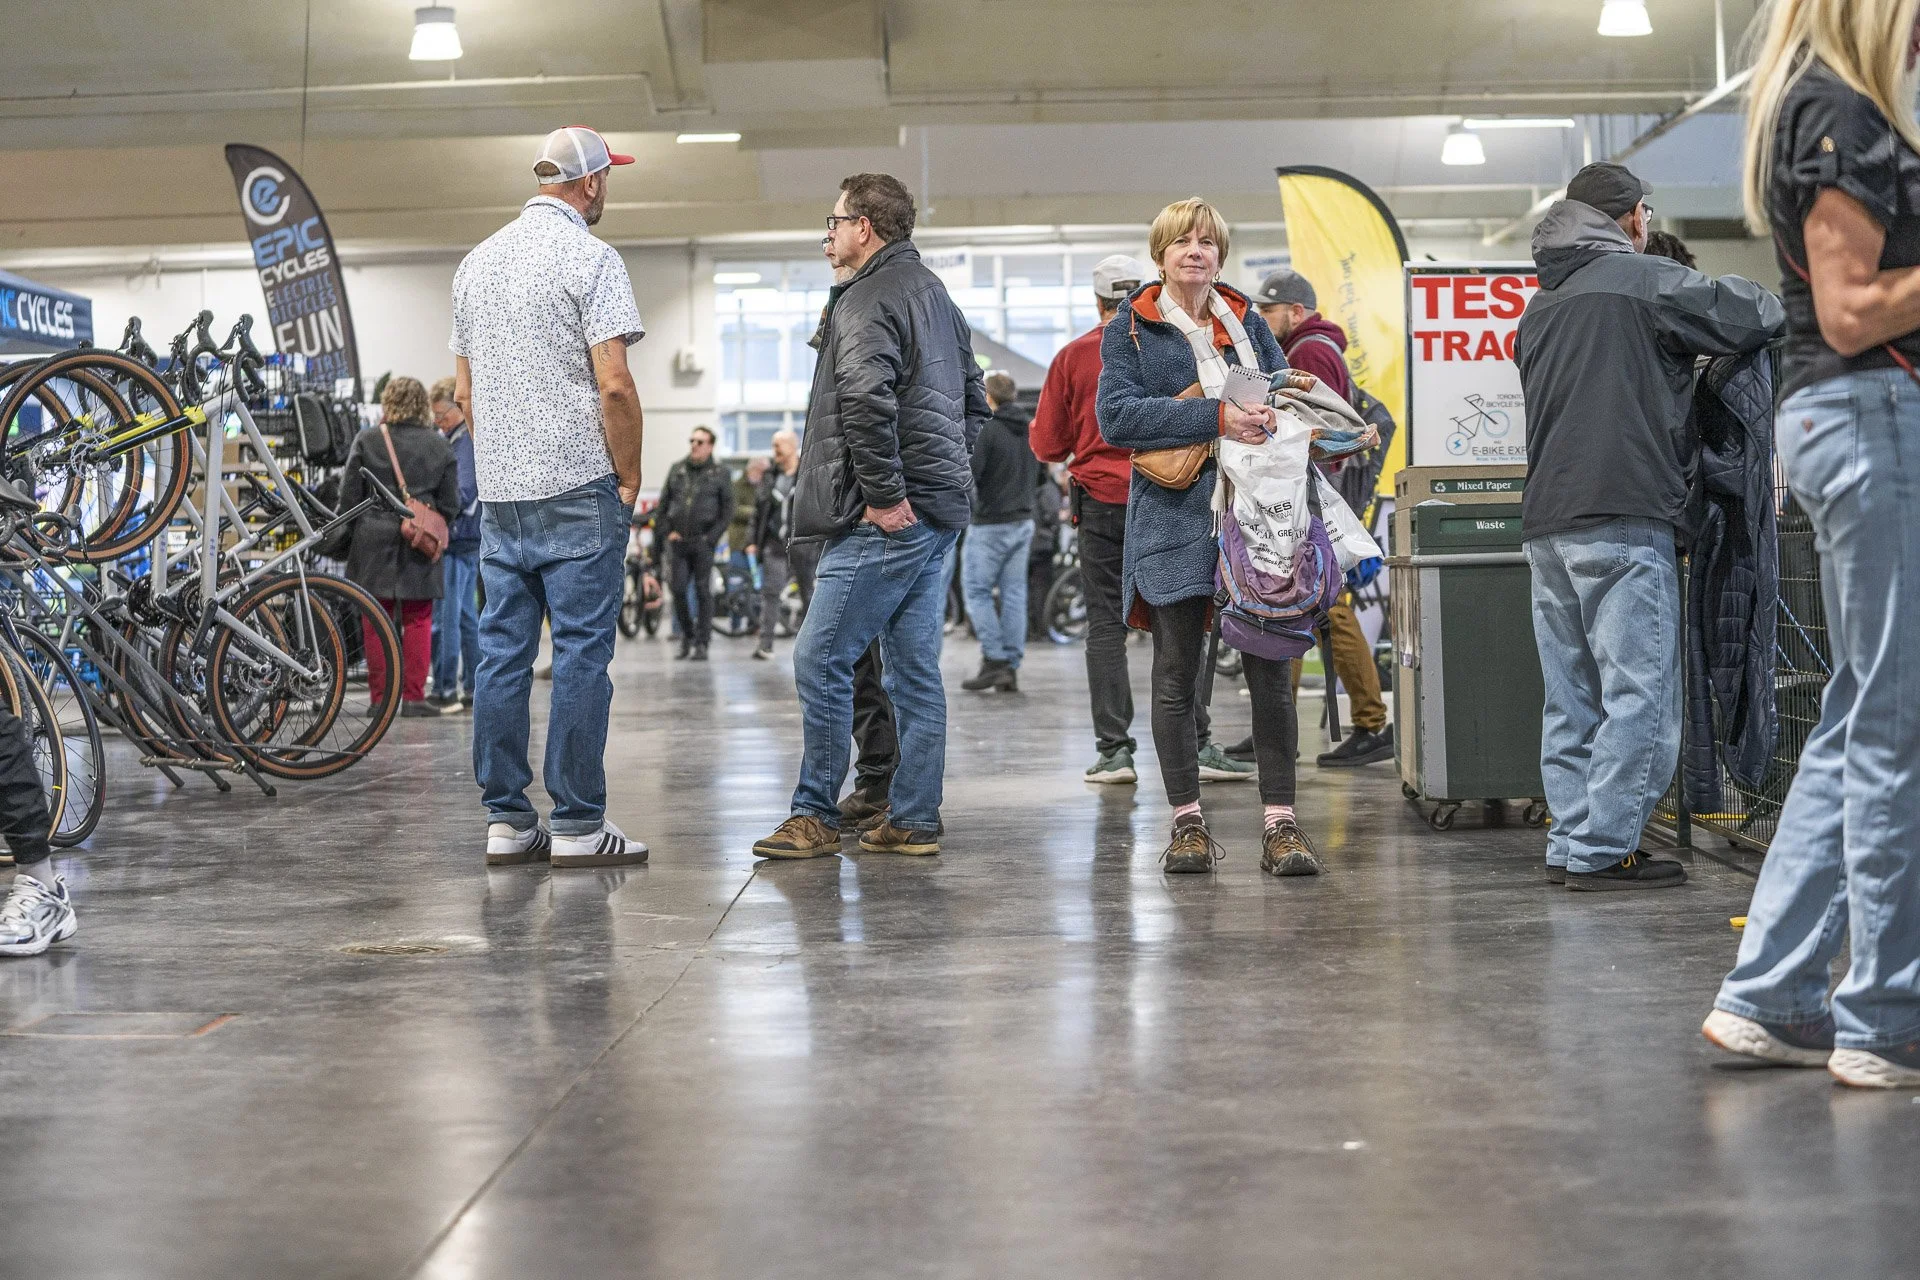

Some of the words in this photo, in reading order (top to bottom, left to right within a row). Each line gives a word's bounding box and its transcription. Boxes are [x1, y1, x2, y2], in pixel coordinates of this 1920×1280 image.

[253, 216, 324, 268] EPIC
[260, 247, 330, 287] CYCLES
[266, 271, 334, 308] ELECTRIC
[270, 289, 337, 325] BICYCLES
[0, 288, 17, 329] IC
[17, 292, 75, 340] CYCLES
[276, 305, 344, 357] FUN
[1472, 446, 1504, 455] E-BIKE
[1457, 482, 1483, 490] Mixed
[1486, 481, 1512, 491] Paper
[1476, 520, 1506, 530] Waste
